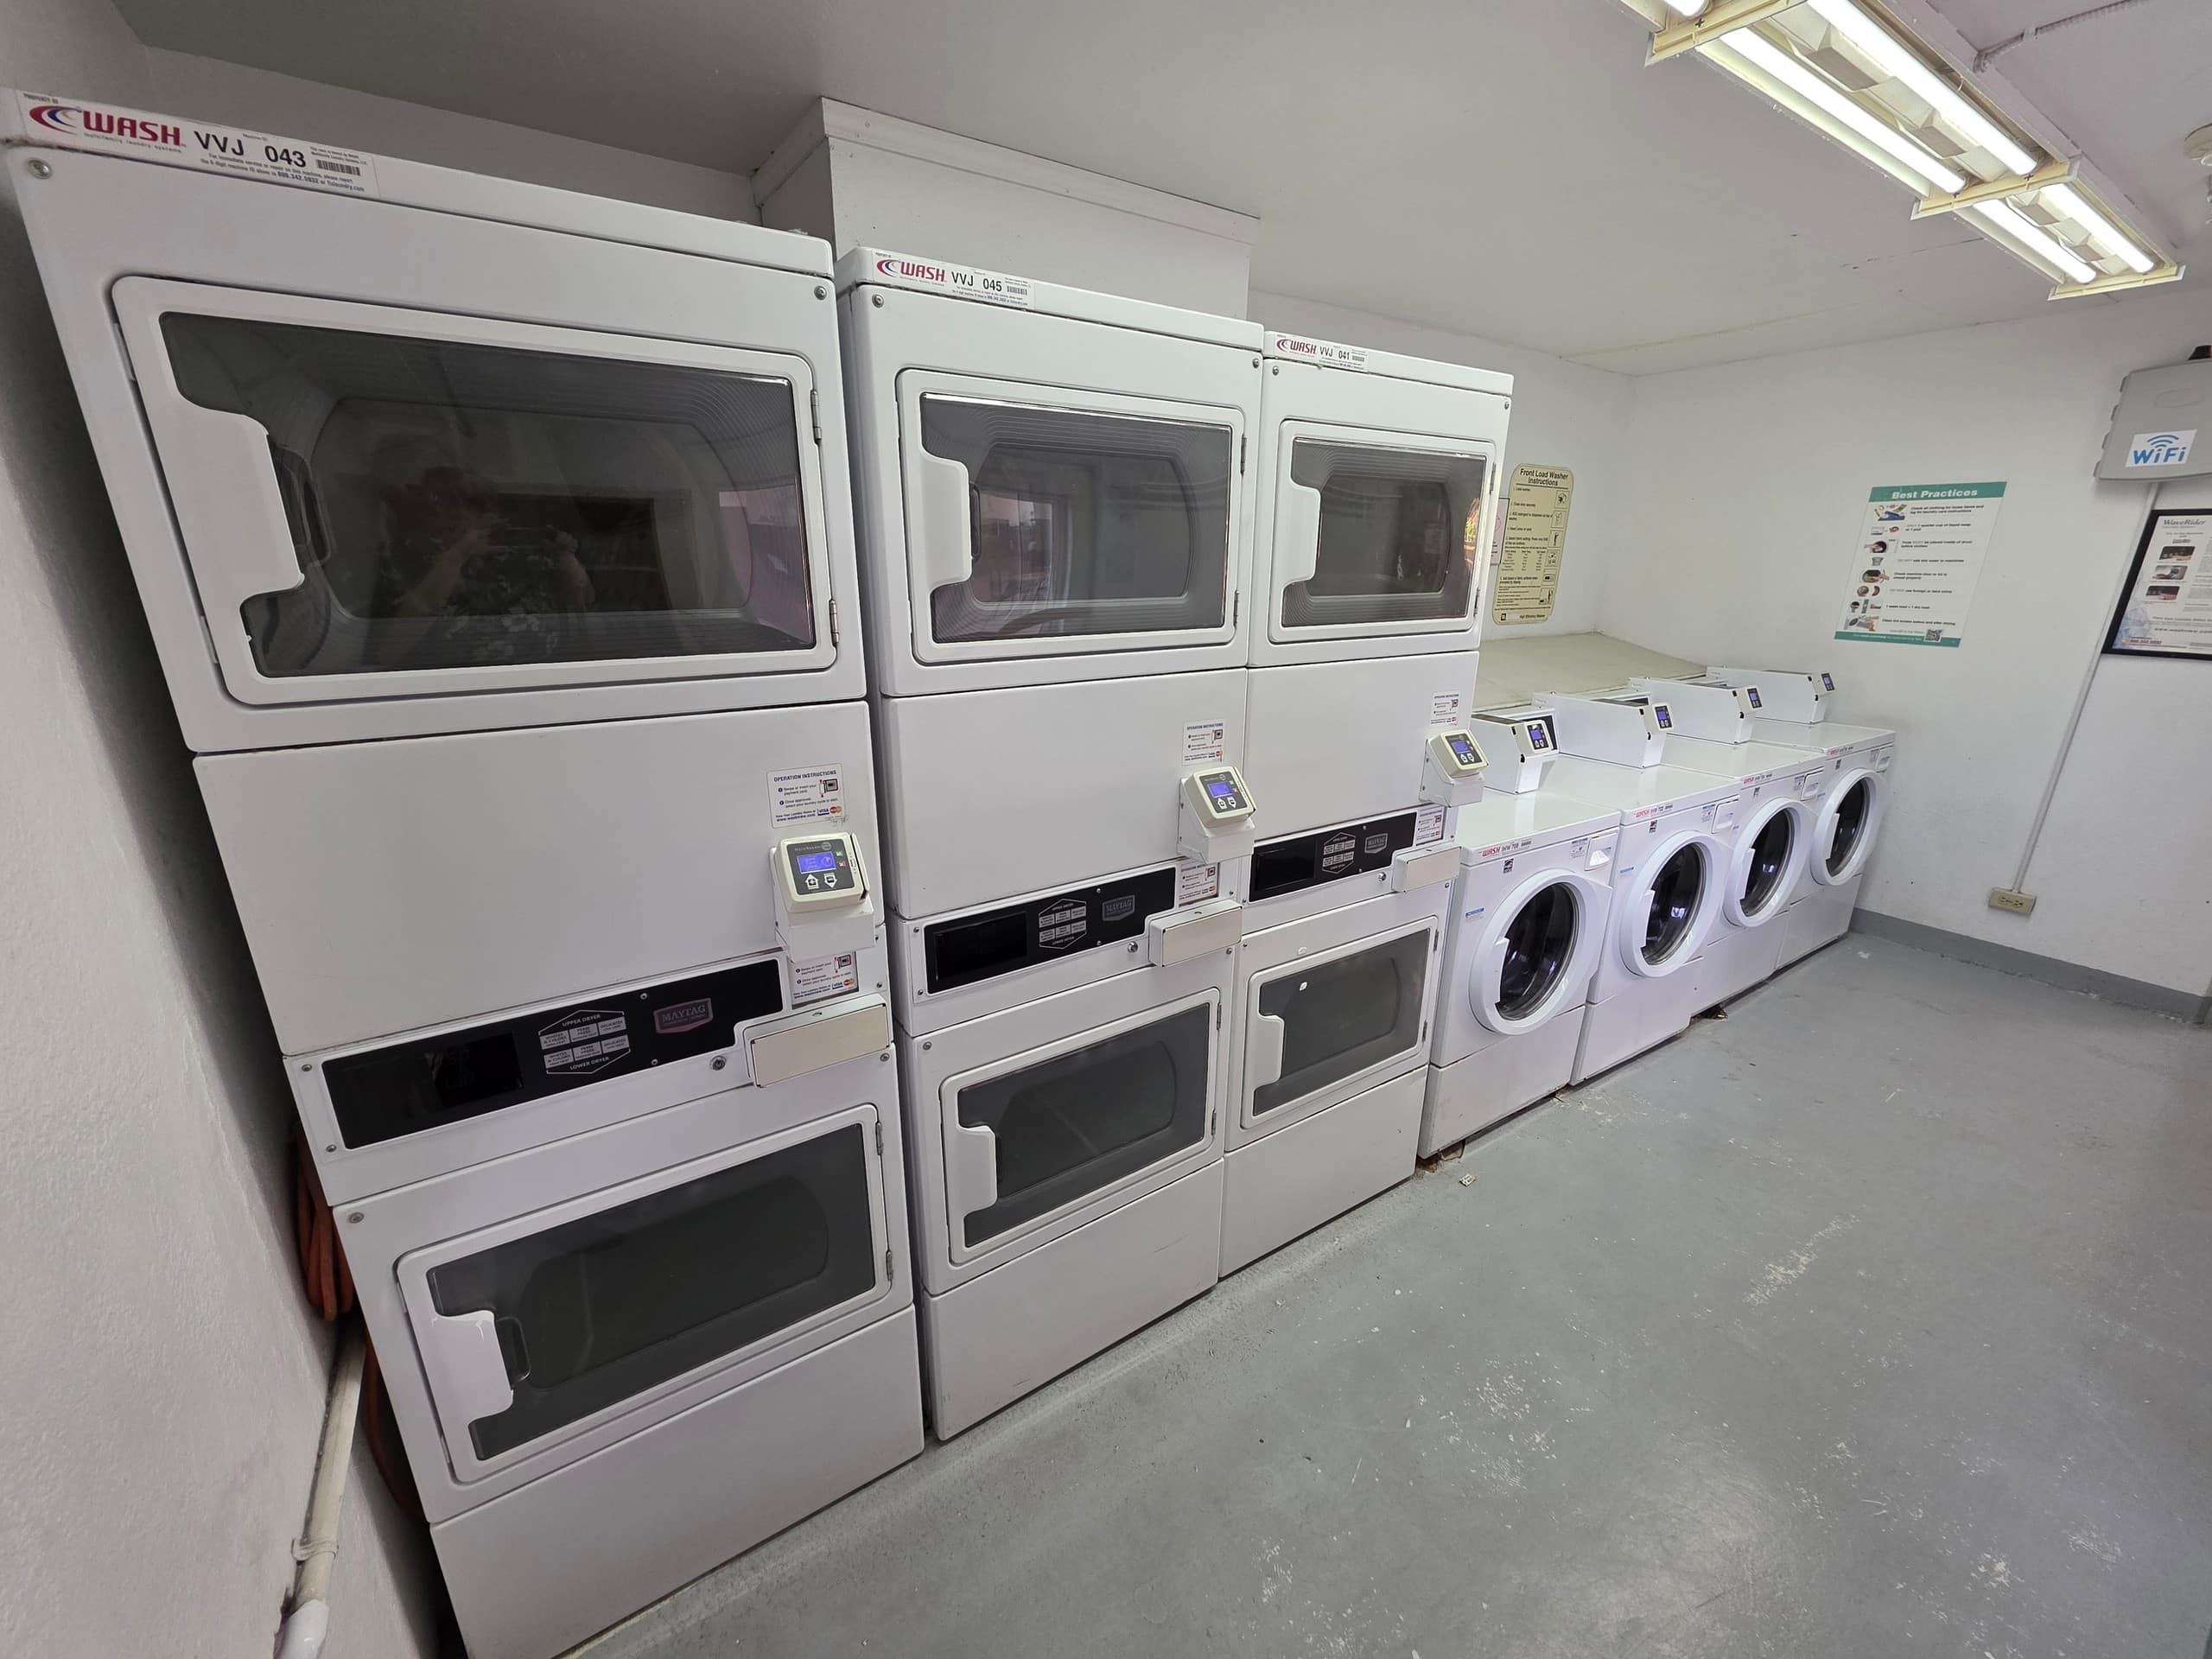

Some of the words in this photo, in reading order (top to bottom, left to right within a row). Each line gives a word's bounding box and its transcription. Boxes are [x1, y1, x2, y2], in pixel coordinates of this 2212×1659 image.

[83, 111, 181, 146] WASH
[194, 130, 244, 156] VVJ
[264, 145, 306, 168] 043
[900, 262, 945, 282] WASH
[951, 271, 974, 286] VVJ
[982, 278, 1002, 291] 045
[1290, 340, 1317, 354] WASH
[1319, 346, 1333, 358] VVJ
[1338, 350, 1350, 360] 041
[2133, 447, 2187, 465] WiFi
[1520, 468, 1535, 477] Front
[1550, 471, 1569, 480] Washer
[1528, 477, 1559, 486] Instructions
[1891, 491, 1918, 499] Best
[1920, 488, 1978, 499] Practices
[802, 770, 836, 779] INSTRUCTIONS
[1482, 846, 1501, 857] WASH
[662, 1004, 706, 1022] MAYTAG
[563, 1019, 582, 1027] UPPER
[582, 1014, 601, 1022] DRYER
[570, 1061, 590, 1071] LOWER
[591, 1056, 609, 1065] DRYER
